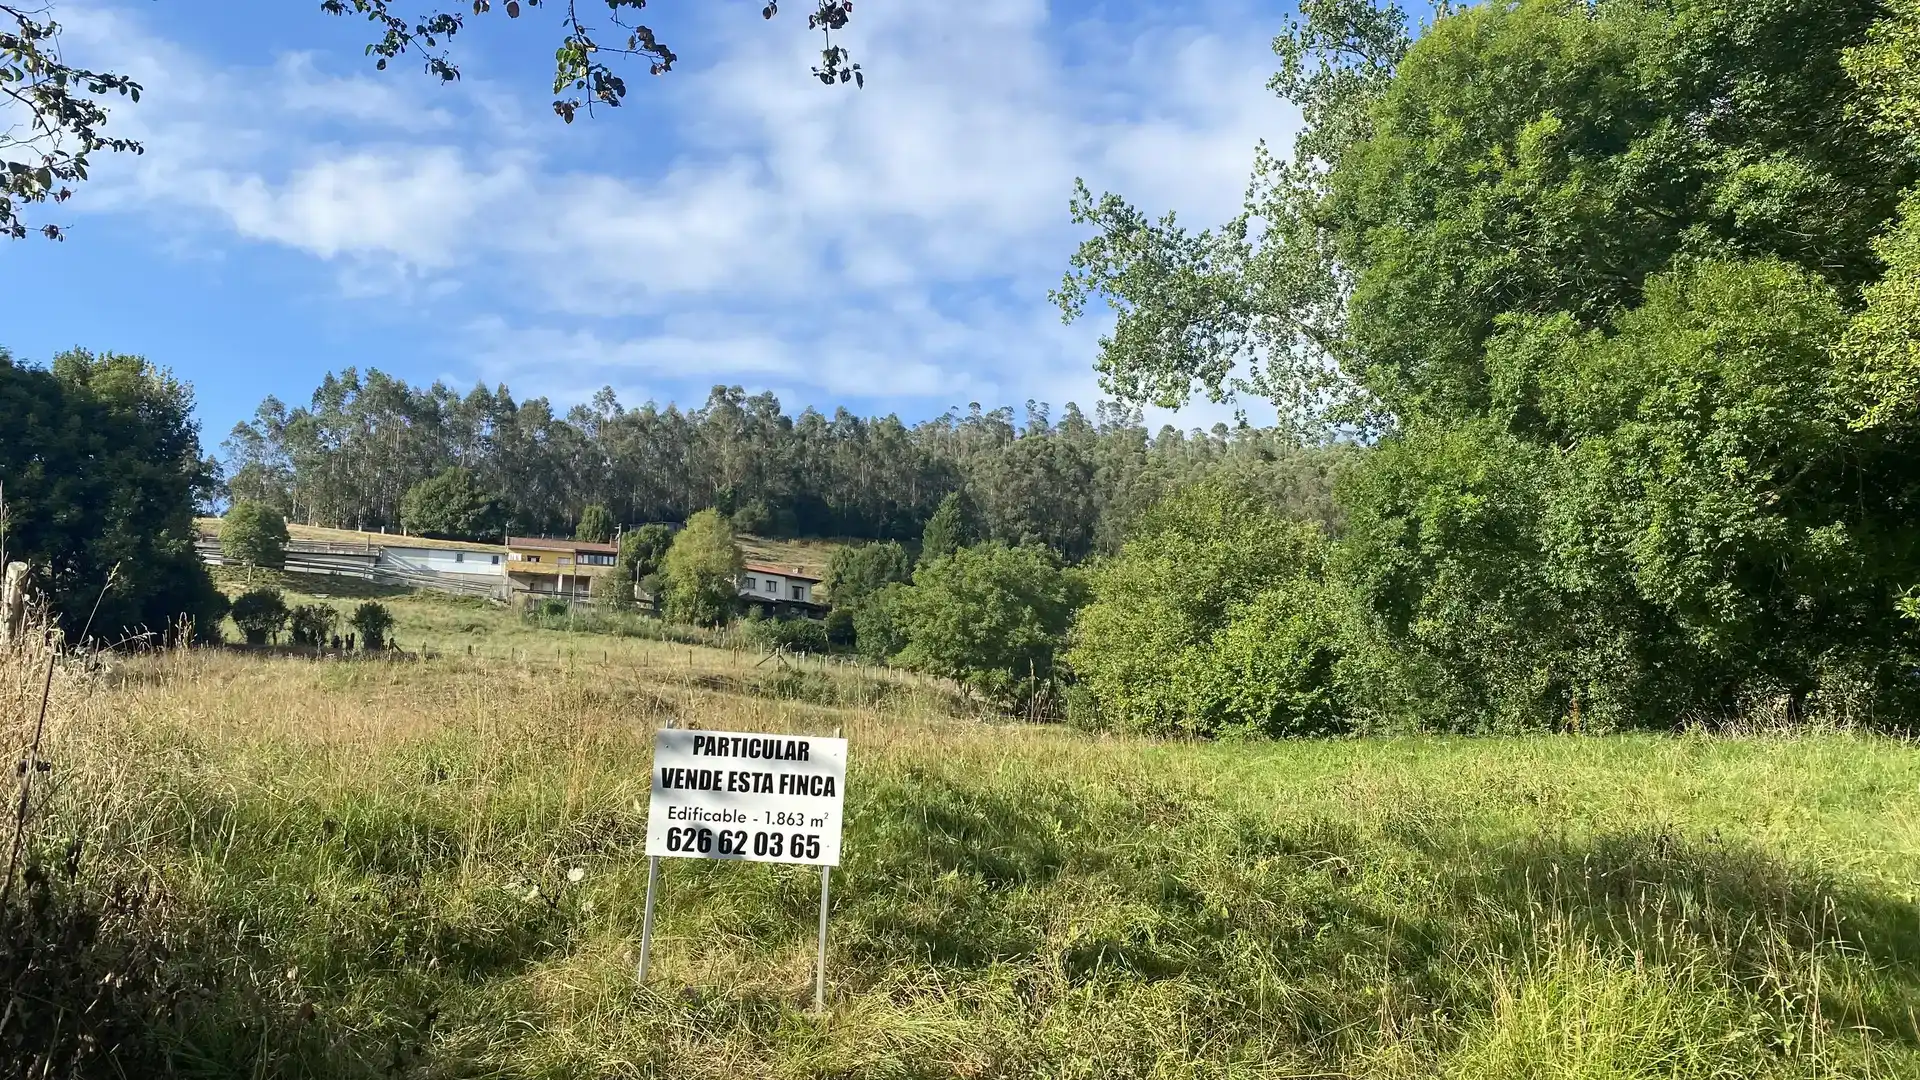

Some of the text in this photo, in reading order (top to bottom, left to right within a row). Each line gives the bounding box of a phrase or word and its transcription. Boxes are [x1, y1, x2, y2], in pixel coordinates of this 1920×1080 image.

[693, 735, 810, 761] PARTICULAR
[661, 767, 836, 797] VENDE ESTA FINCA
[668, 806, 747, 824] Edificable
[765, 811, 805, 827] 1.863
[666, 826, 821, 860] 626 62 03 65
